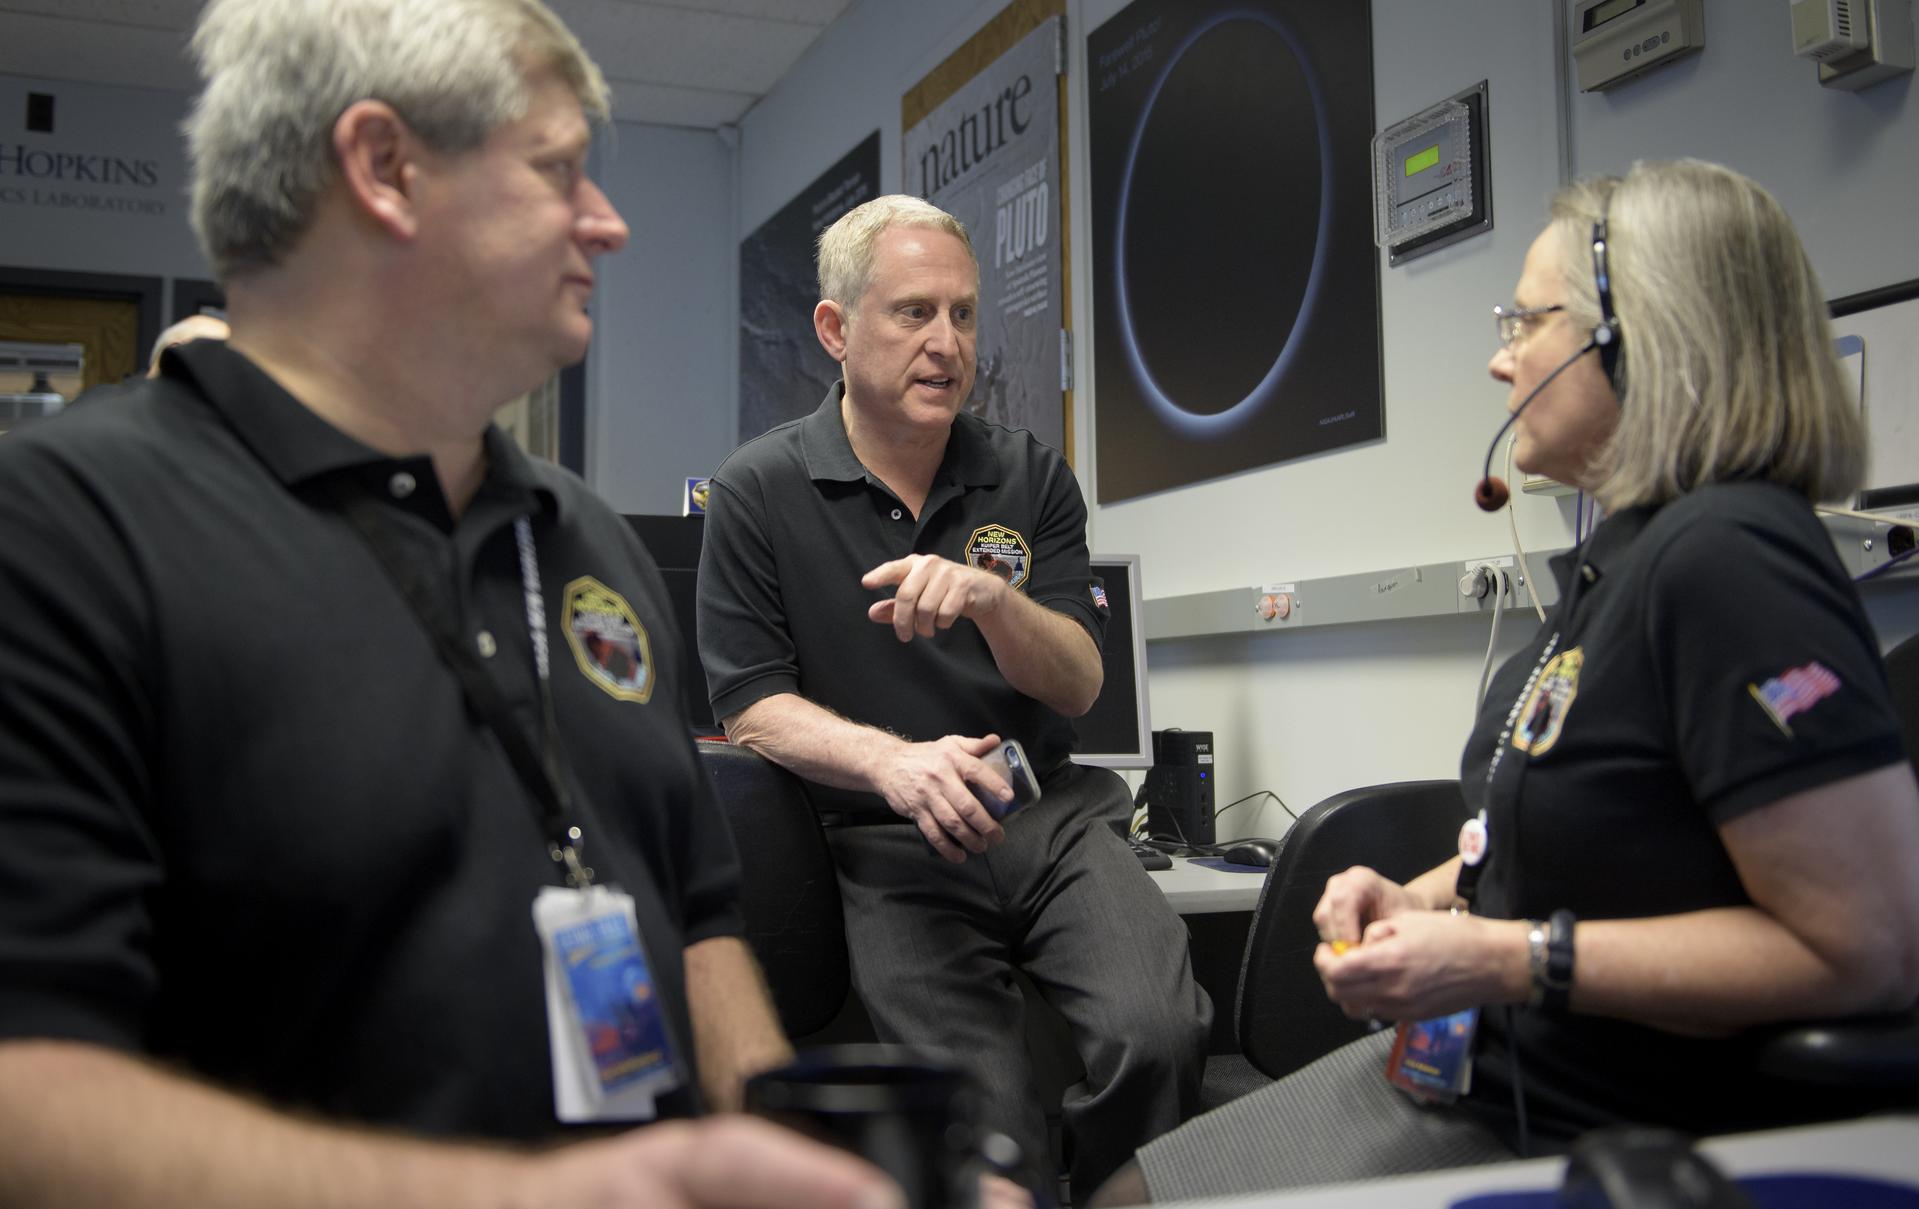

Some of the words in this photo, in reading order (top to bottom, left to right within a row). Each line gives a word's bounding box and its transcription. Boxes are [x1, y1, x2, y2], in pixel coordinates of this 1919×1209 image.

[920, 74, 1032, 200] nature
[0, 143, 158, 188] HOPKINS
[33, 188, 166, 217] LABORATORY
[996, 181, 1049, 269] PLUTO
[977, 536, 1017, 545] HORIZONS
[987, 530, 1005, 538] NEW
